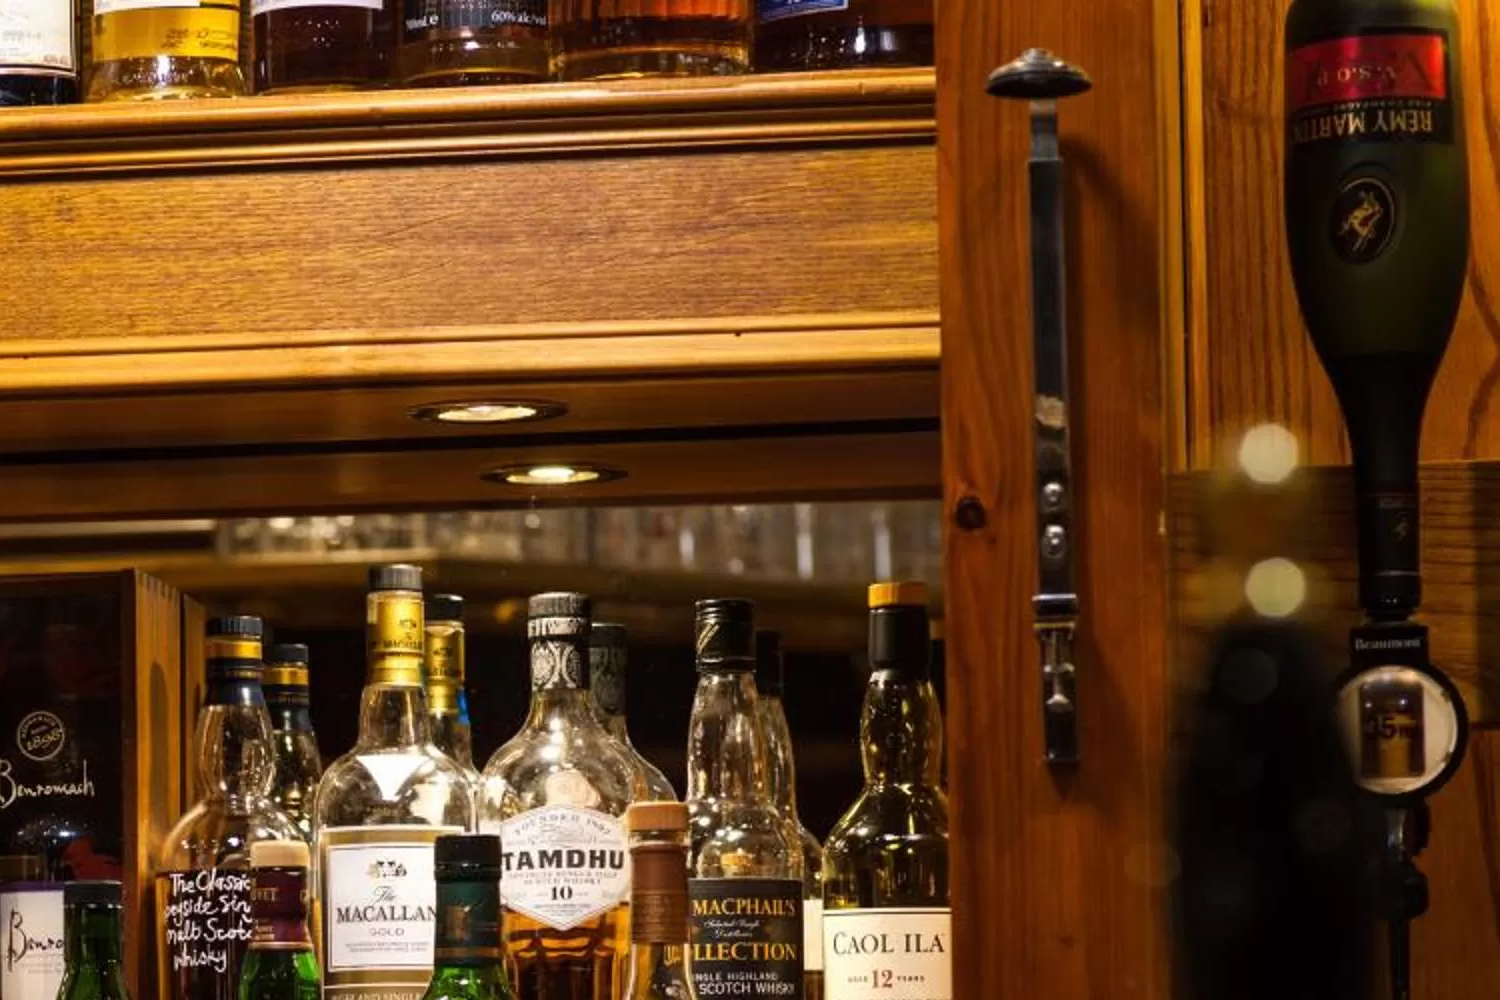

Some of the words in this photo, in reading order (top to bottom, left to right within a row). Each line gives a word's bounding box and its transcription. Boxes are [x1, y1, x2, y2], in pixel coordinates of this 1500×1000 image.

[502, 849, 625, 871] TAMDHU
[171, 872, 196, 898] The
[551, 885, 574, 901] 10
[370, 927, 405, 937] GOLD
[833, 931, 894, 955] CAOL
[904, 932, 946, 954] ILA
[727, 971, 779, 982] HIGHLAND
[871, 968, 894, 989] 12
[699, 981, 752, 996] SCOTCH
